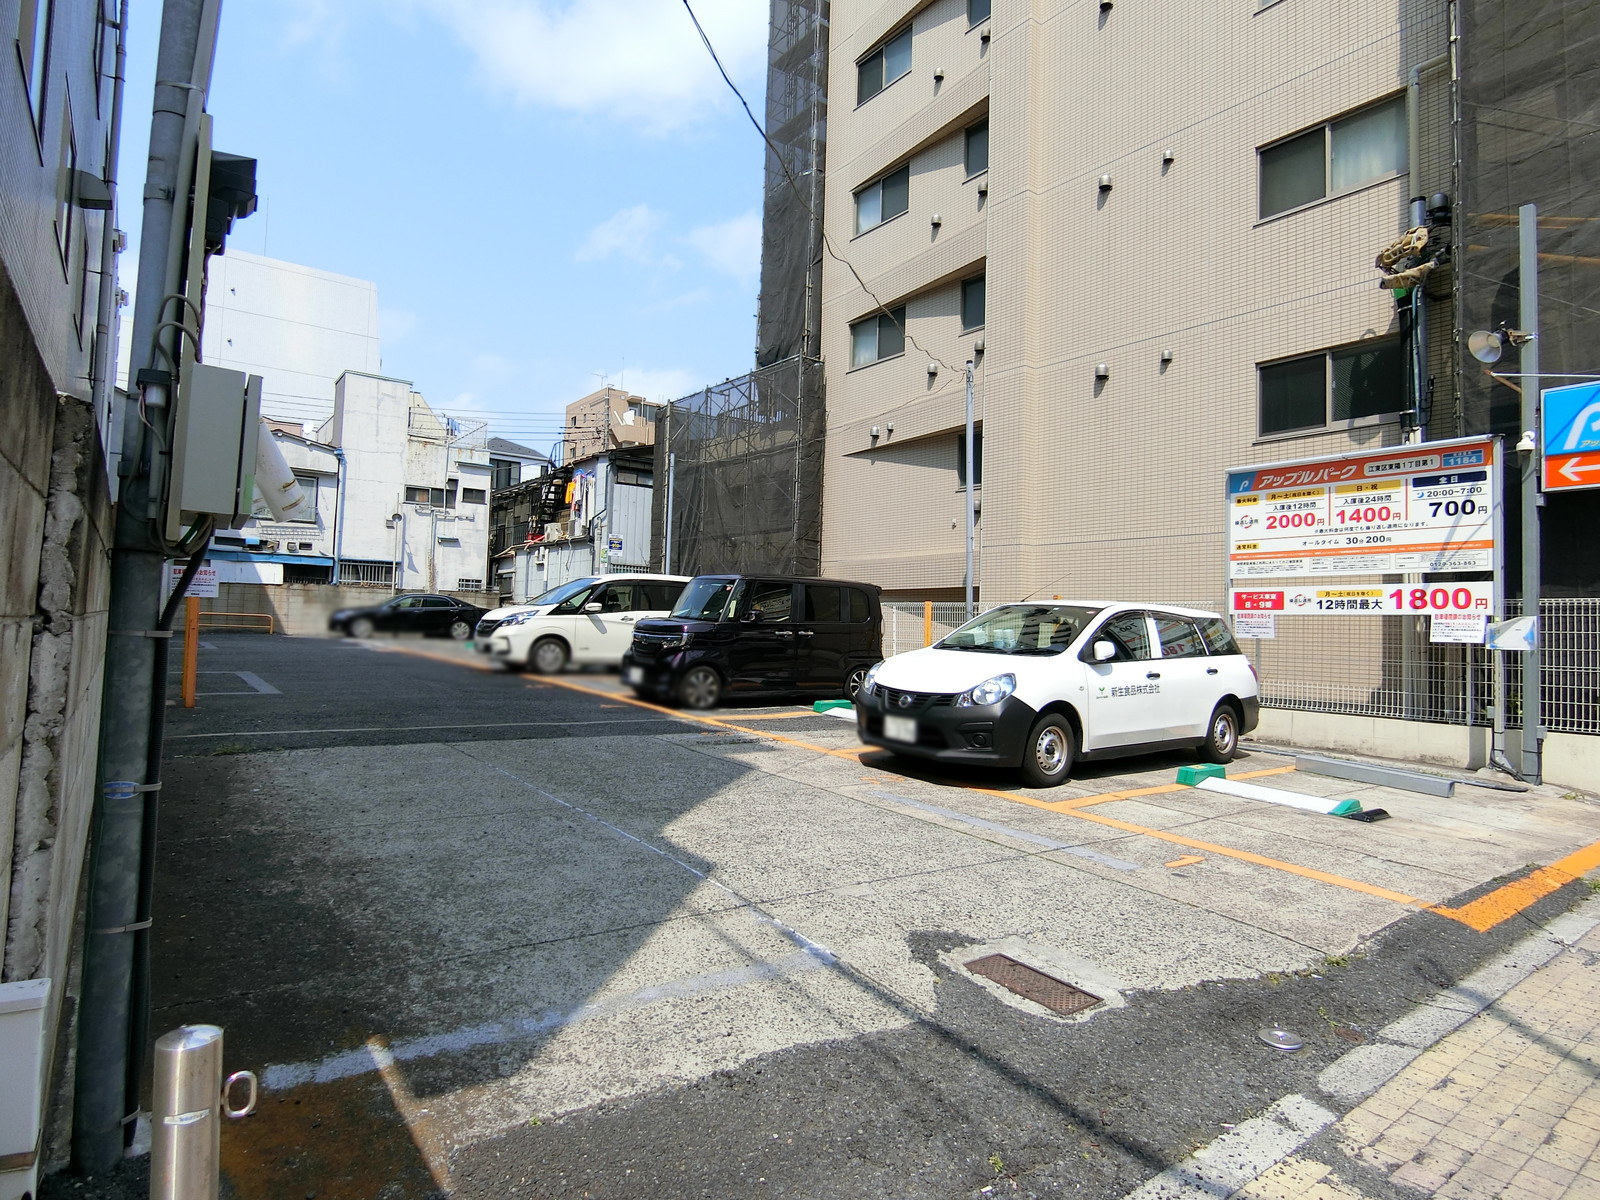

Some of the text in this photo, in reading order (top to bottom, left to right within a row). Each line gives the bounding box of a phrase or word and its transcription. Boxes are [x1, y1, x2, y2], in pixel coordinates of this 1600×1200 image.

[1448, 455, 1477, 466] 1184
[1258, 465, 1357, 488] アップルパーク
[1273, 502, 1316, 511] 入庫後12時間
[1343, 494, 1392, 505] 入庫後24時間
[1428, 499, 1488, 518] 700円
[1266, 512, 1325, 530] 2000円
[1336, 505, 1401, 525] 1400円
[1316, 587, 1488, 610] 12時間最大 1800円
[1111, 683, 1160, 697] 新生食品株式会社
